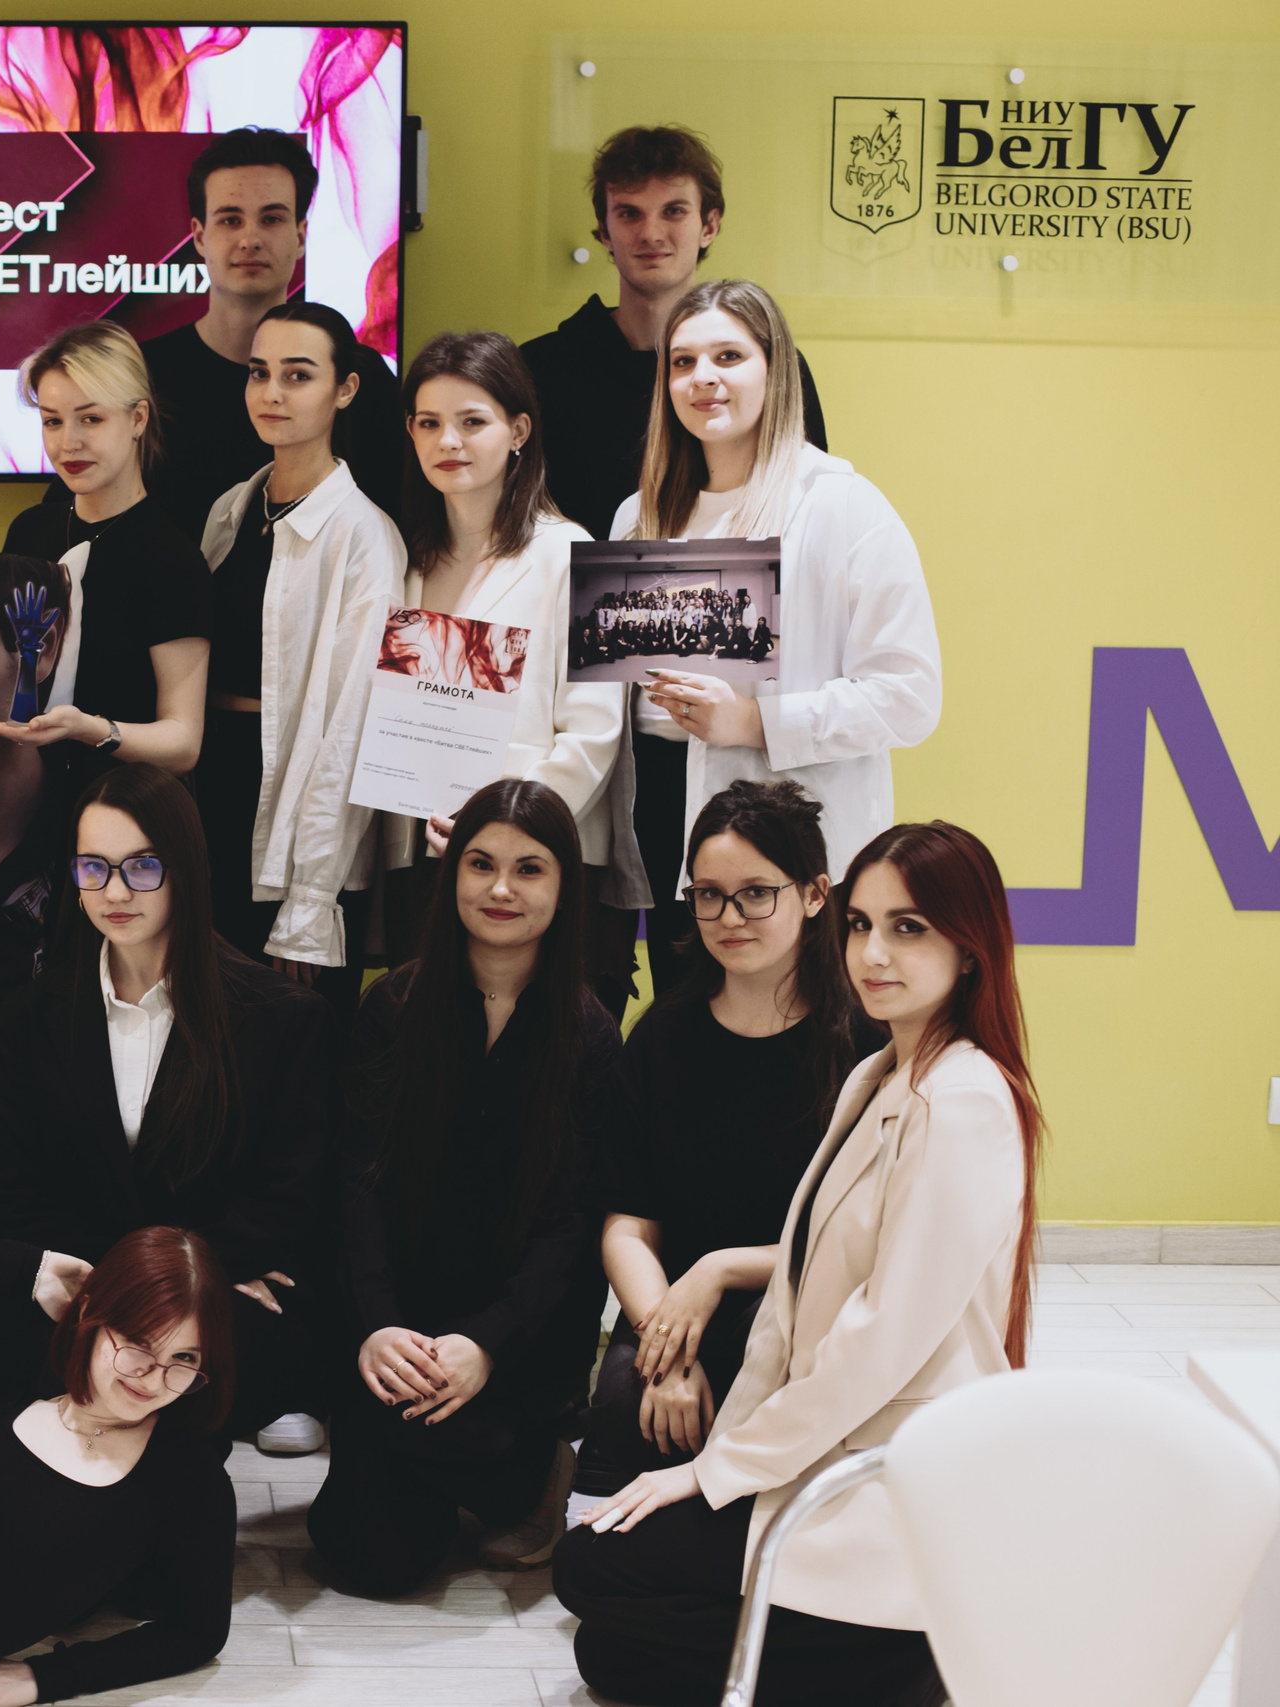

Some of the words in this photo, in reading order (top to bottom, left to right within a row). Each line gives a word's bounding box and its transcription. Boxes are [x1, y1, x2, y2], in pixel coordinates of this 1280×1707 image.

[1001, 100, 1075, 125] НИУ
[936, 99, 1196, 175] БелГУ
[936, 183, 1098, 208] BELGOROD
[1106, 187, 1192, 211] STATE
[857, 204, 895, 218] 1876
[935, 213, 1109, 238] UNIVERSITY
[1117, 214, 1191, 245] (BSU)
[416, 681, 474, 700] ГРАМОТА
